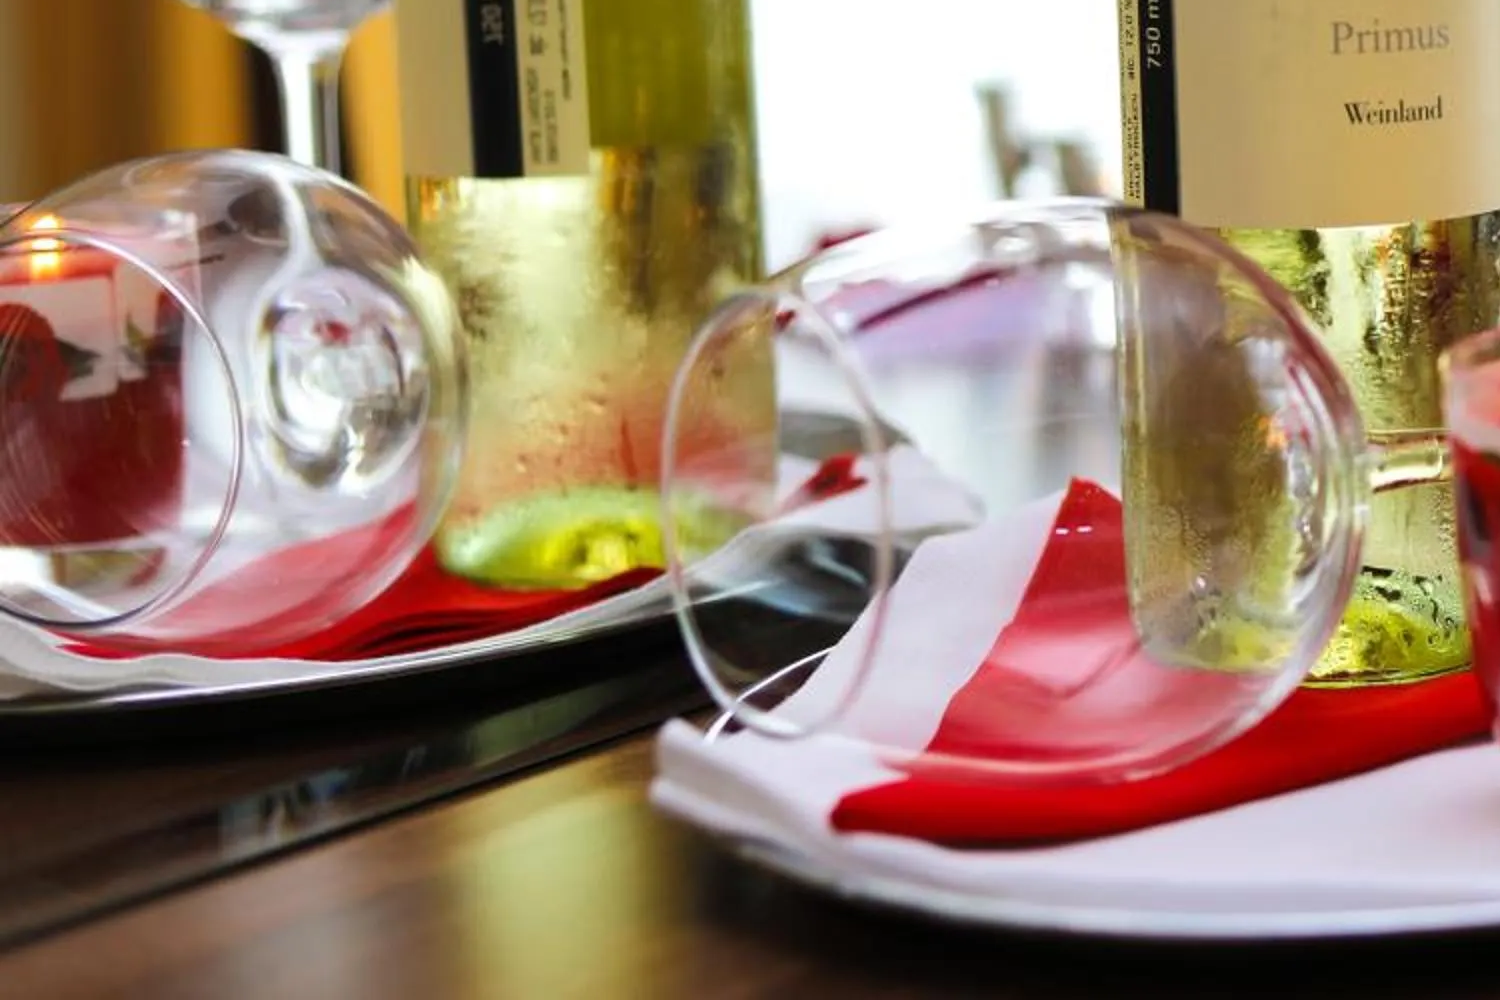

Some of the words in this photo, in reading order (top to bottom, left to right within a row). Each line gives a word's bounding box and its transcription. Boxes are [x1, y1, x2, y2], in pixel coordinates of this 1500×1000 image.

[1145, 27, 1162, 68] 750
[1331, 18, 1450, 55] Primus
[1344, 95, 1443, 125] Weinland
